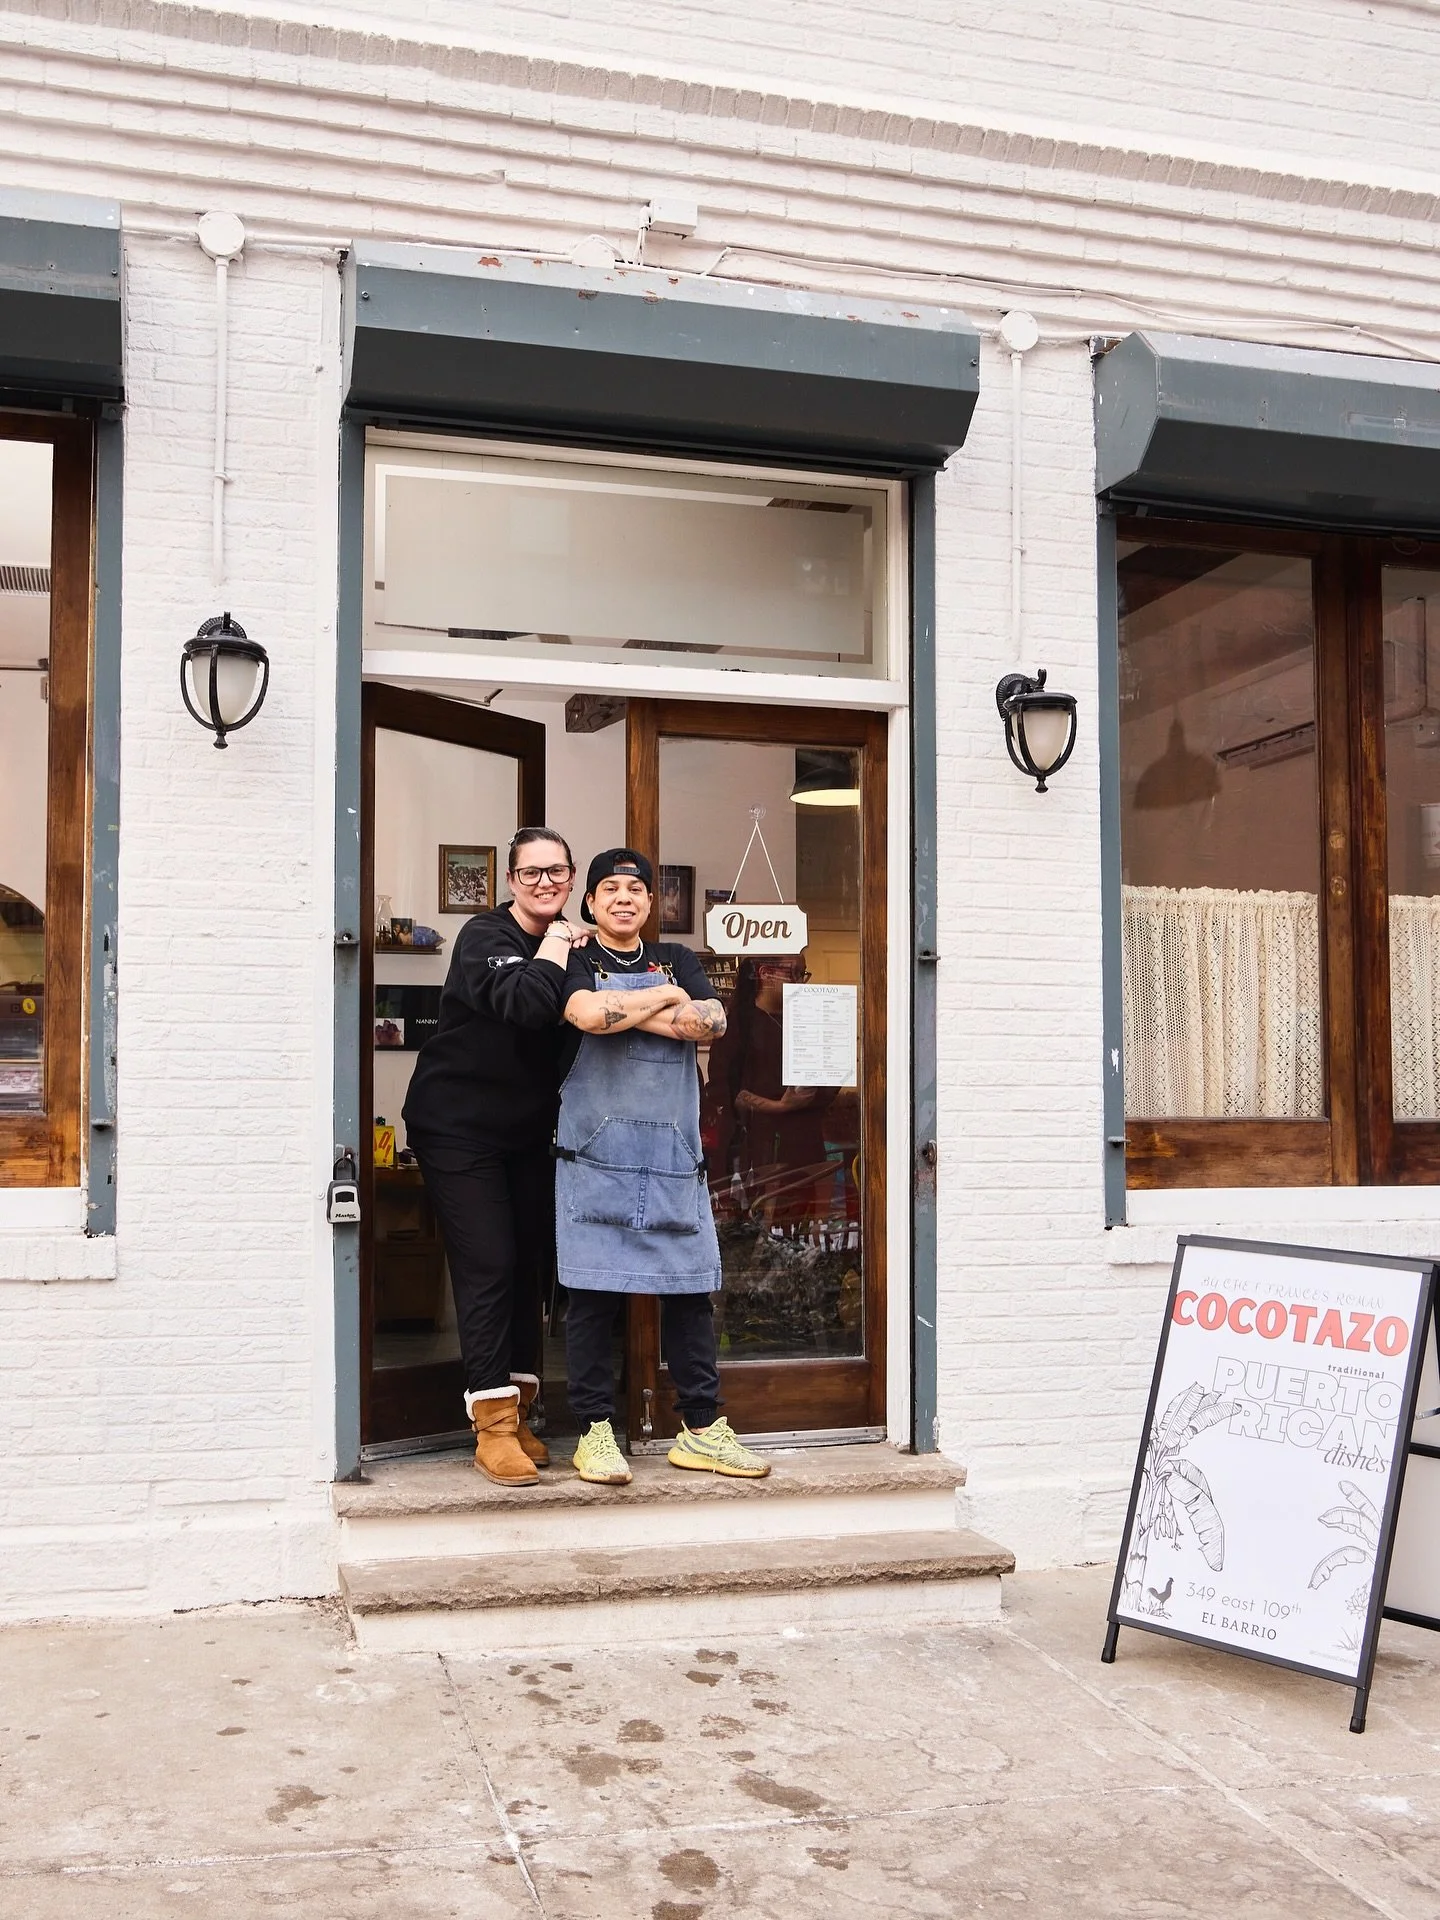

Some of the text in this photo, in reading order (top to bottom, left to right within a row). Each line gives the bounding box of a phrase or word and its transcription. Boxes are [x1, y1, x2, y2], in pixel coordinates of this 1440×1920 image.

[721, 911, 792, 947] Open
[1171, 1290, 1410, 1357] COCOTAZO
[1212, 1356, 1404, 1421] PUERTO
[1327, 1364, 1386, 1380] traditional
[1228, 1398, 1399, 1464] RICAN
[1323, 1442, 1387, 1474] dishes
[1185, 1581, 1302, 1620] 349 east 109th
[1201, 1612, 1278, 1641] EL BARRIO
